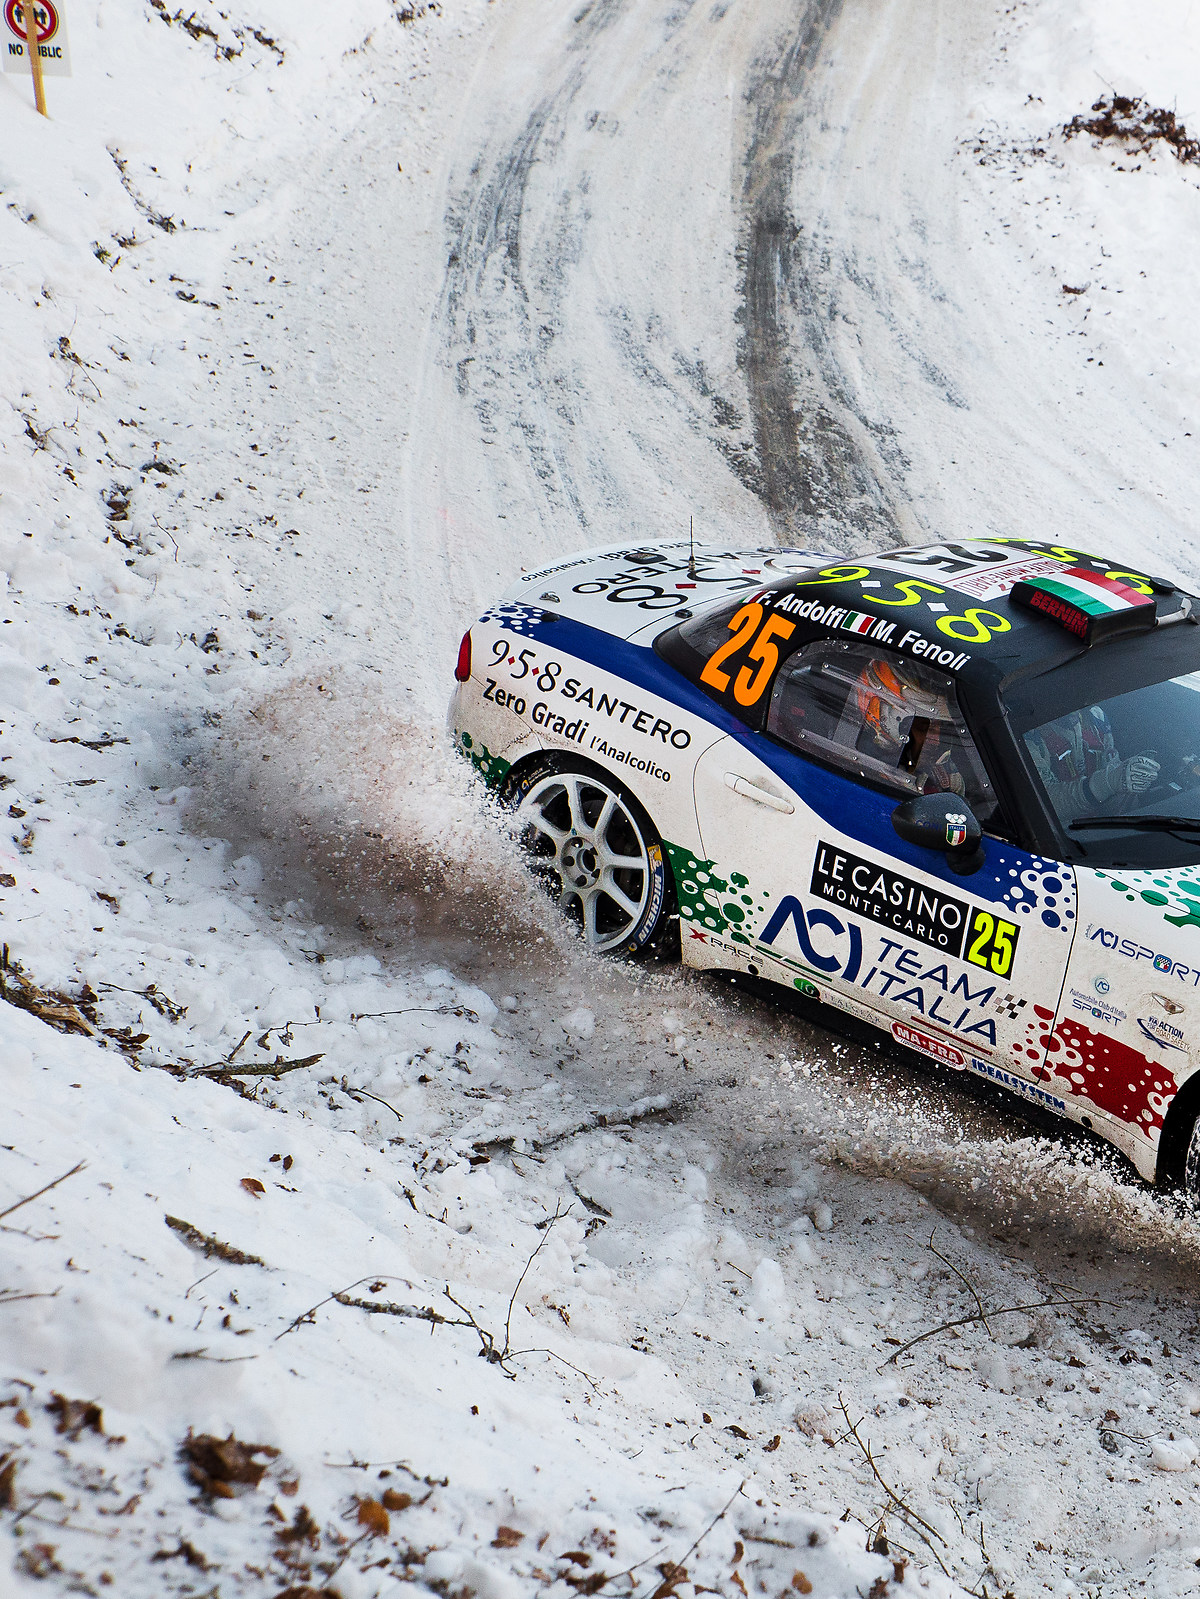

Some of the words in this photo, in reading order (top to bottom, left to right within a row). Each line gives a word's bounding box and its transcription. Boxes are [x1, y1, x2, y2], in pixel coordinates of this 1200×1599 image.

[8, 43, 23, 56] NO
[38, 45, 62, 58] BLIC
[572, 551, 769, 594] SANTERO
[877, 543, 1008, 574] 25
[700, 602, 796, 707] 25
[758, 590, 779, 606] F.
[774, 593, 848, 629] Andolfi
[870, 620, 898, 644] M.
[897, 630, 971, 671] Fenoli
[483, 677, 527, 715] Zero
[531, 702, 589, 744] Gradi
[590, 735, 671, 783] l'Analcolico
[561, 678, 692, 750] SANTERO
[637, 874, 663, 943] MICHELIN
[818, 849, 847, 882] LE
[851, 866, 962, 929] CASINO
[877, 936, 997, 1008] TEAM
[967, 912, 1017, 976] 25
[861, 966, 998, 1047] ITALIA
[1072, 998, 1122, 1027] SPORT
[1159, 1020, 1185, 1040] ACTION
[971, 1058, 1066, 1111] IDEALSYSTEM
